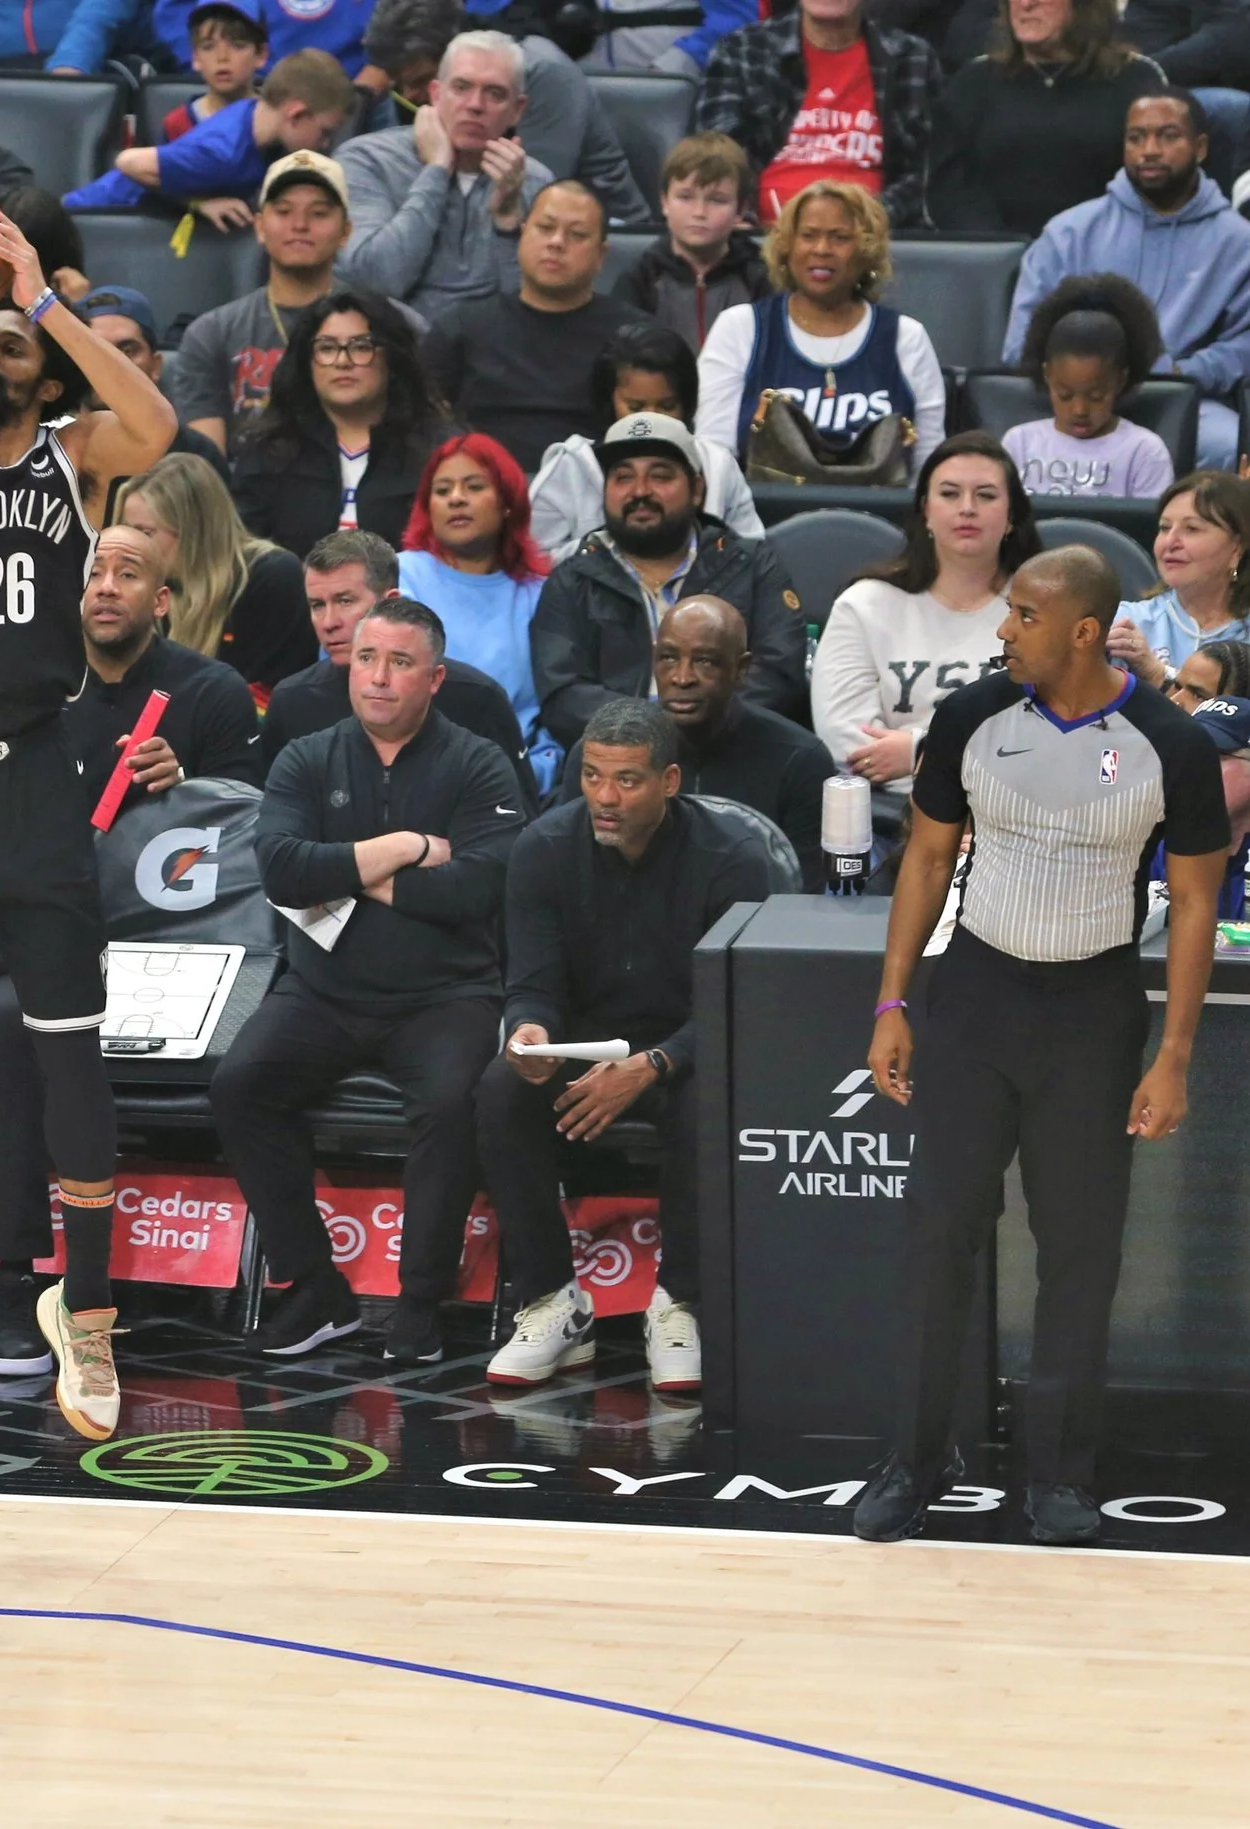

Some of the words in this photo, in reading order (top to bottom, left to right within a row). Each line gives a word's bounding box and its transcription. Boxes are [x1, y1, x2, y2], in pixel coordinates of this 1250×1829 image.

[1191, 697, 1239, 717] lips
[738, 1128, 916, 1167] STARL
[116, 1187, 233, 1222] Cedars
[128, 1219, 211, 1251] Sinai
